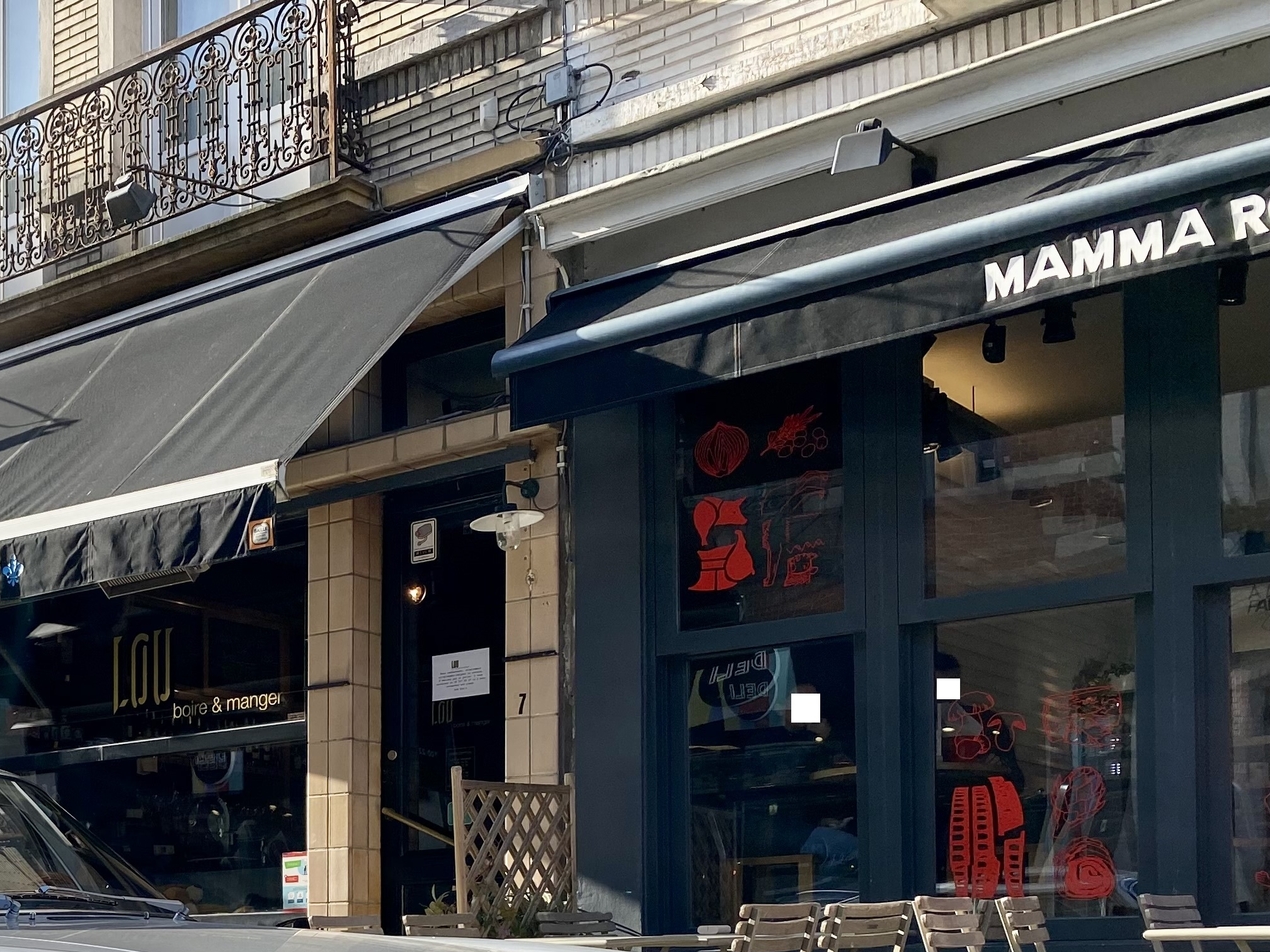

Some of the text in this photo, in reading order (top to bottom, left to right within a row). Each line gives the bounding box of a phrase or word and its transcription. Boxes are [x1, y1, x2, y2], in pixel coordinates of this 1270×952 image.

[984, 193, 1270, 302] MAMMA R
[113, 627, 174, 715] LOU
[173, 692, 282, 719] boire & manger
[518, 693, 527, 715] 7
